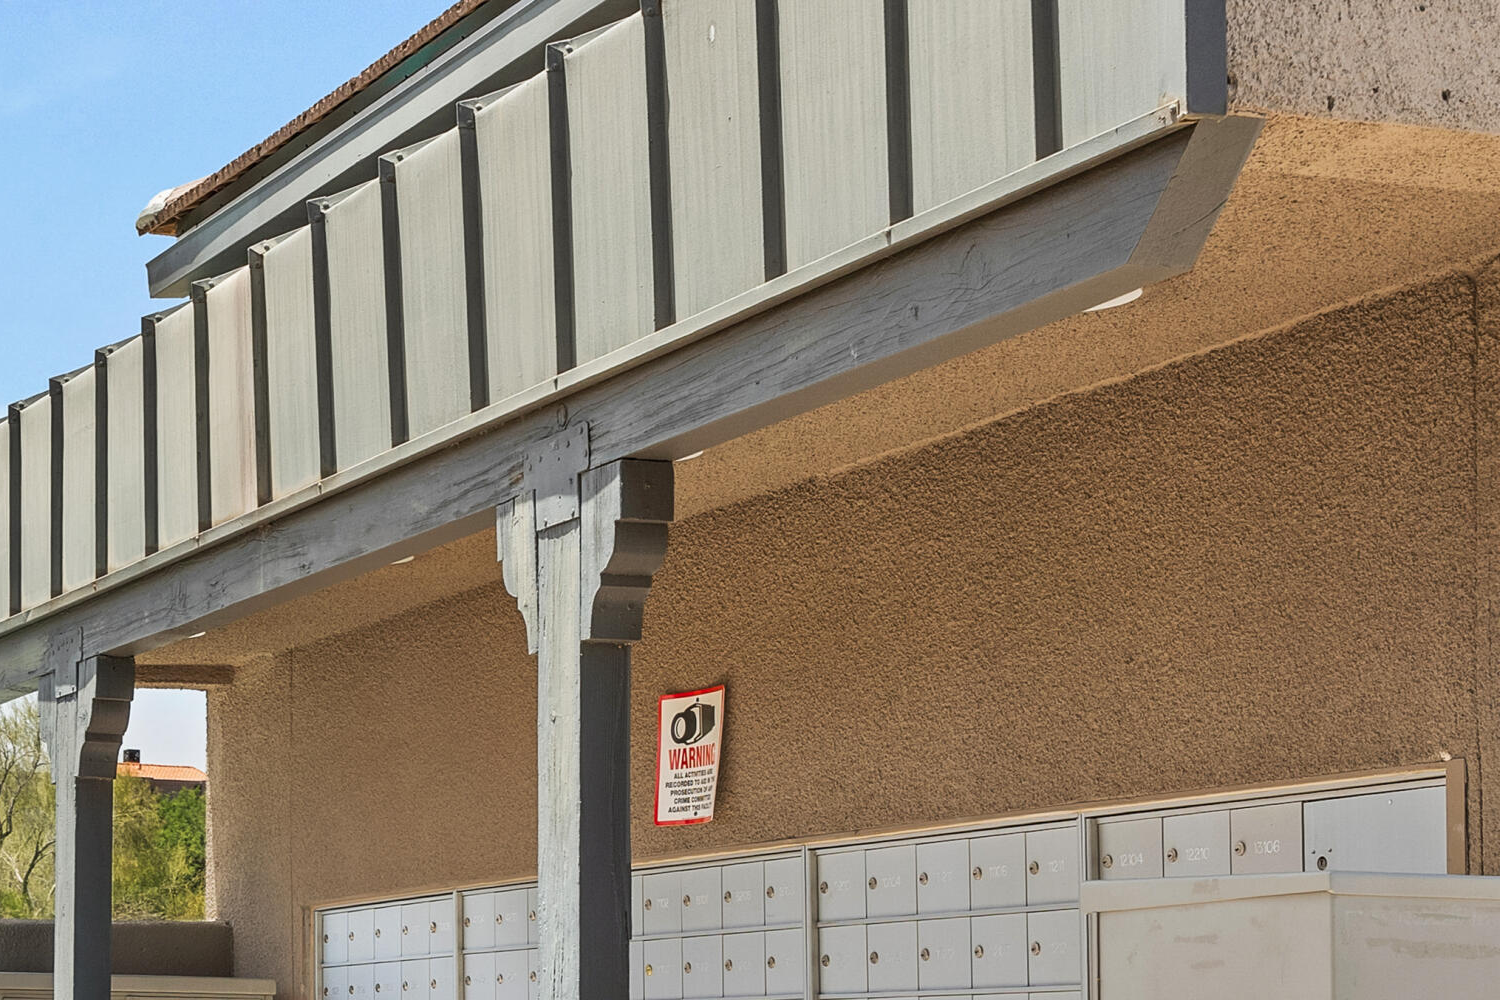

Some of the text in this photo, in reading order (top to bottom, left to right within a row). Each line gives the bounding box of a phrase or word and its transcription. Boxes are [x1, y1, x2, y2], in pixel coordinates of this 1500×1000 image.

[668, 743, 715, 770] WARNING
[685, 770, 706, 778] ACTIVITIES
[665, 780, 693, 788] RECORDED
[670, 787, 703, 796] PROSECUTION
[668, 805, 691, 813] AGAINST
[1253, 839, 1282, 855] 13106
[1118, 852, 1144, 866] 12104
[1185, 847, 1210, 861] 12210
